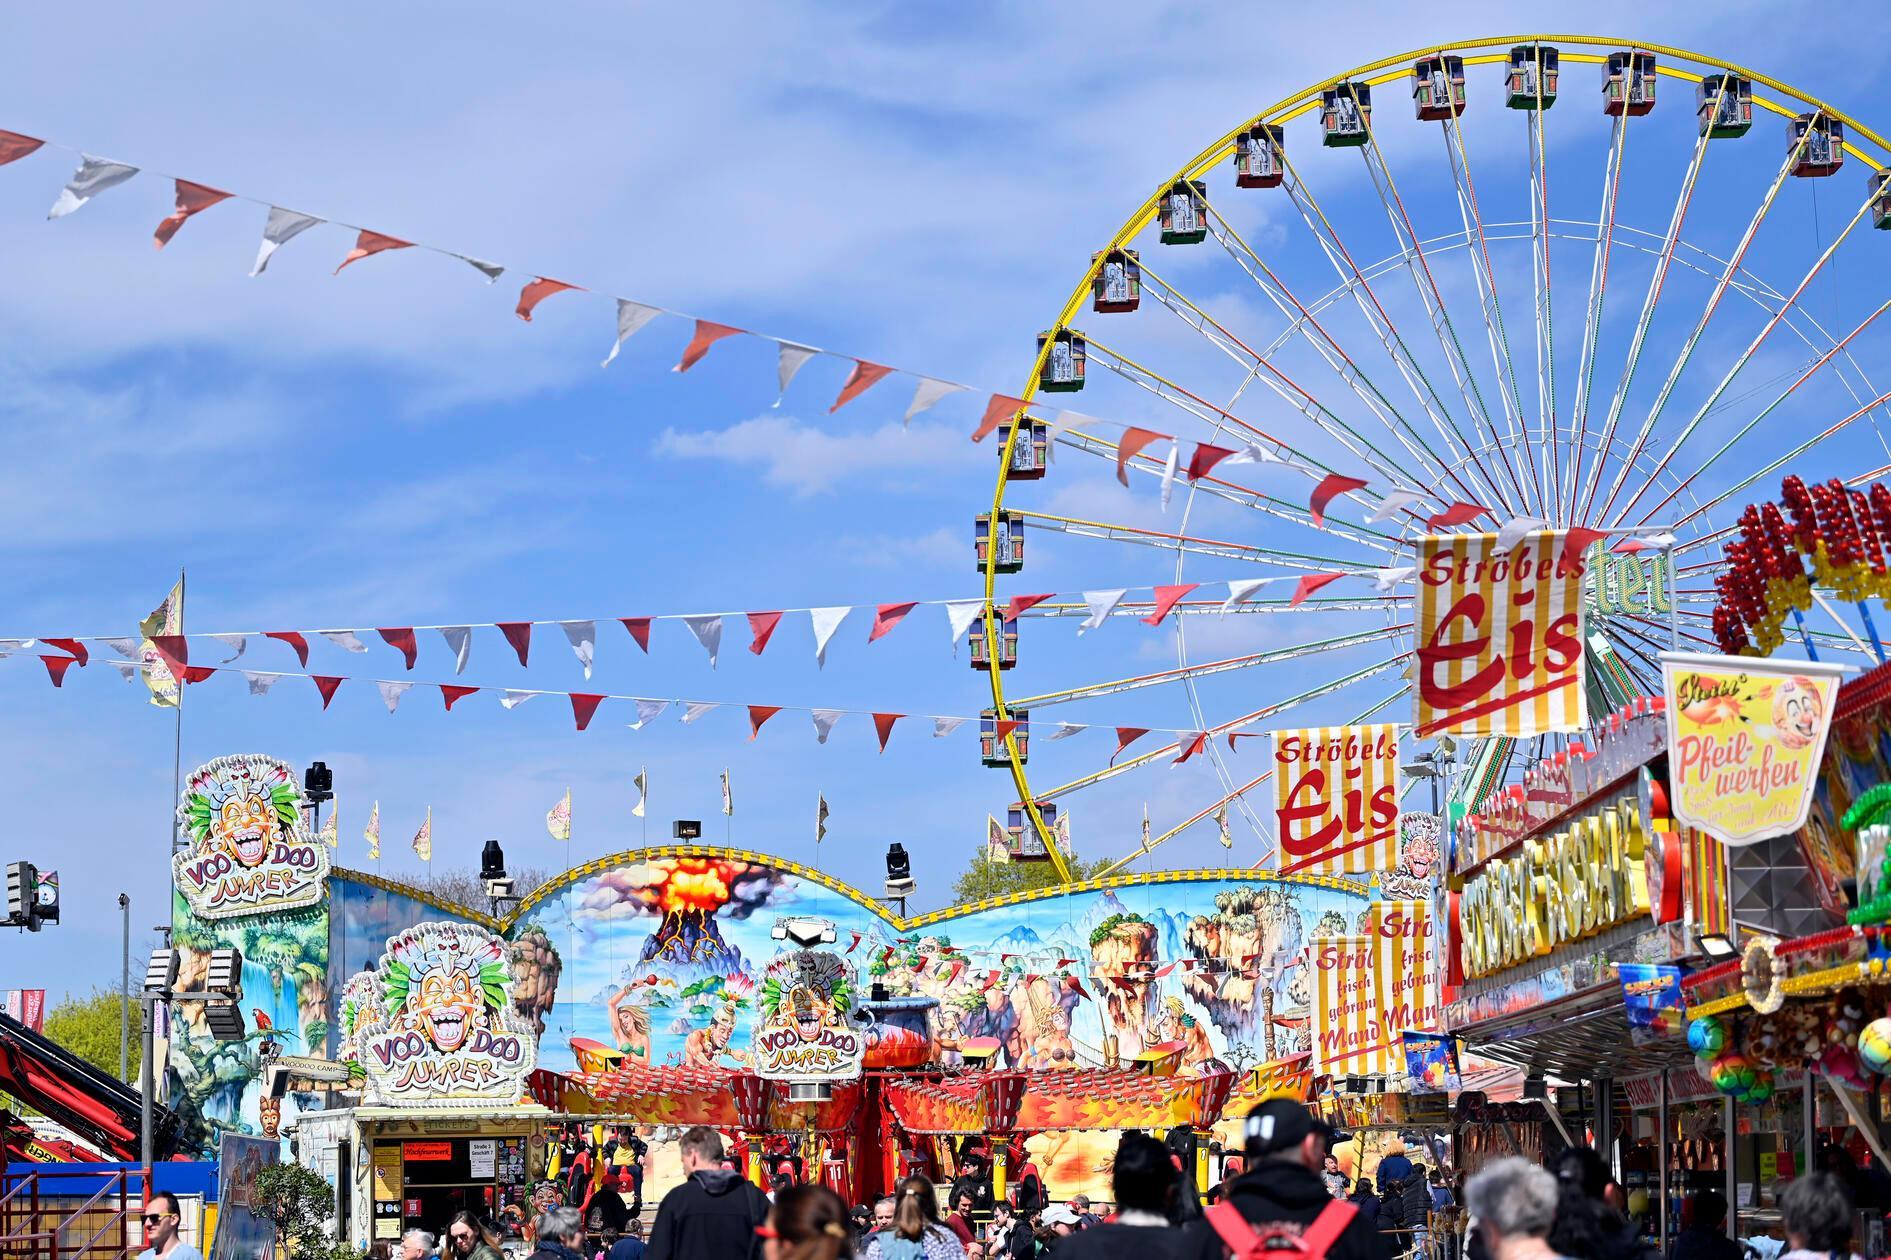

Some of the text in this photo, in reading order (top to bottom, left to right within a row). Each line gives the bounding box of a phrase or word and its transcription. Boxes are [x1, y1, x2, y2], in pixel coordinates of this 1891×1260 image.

[1420, 546, 1586, 586] Ströbels
[1417, 588, 1582, 710] Eis
[1275, 733, 1397, 763] Ströbels
[1677, 732, 1754, 785] Pfeil-
[1715, 744, 1800, 798] werfen
[1276, 766, 1398, 856] Eis
[186, 843, 315, 886] VOO DOO
[211, 868, 300, 904] JUMPER
[1378, 911, 1433, 938] Strö
[1401, 949, 1434, 970] frisc
[1337, 973, 1371, 998] frisch
[1392, 971, 1435, 997] gebra
[1383, 1002, 1436, 1032] Man
[373, 1028, 520, 1066] VOO DOO
[760, 1029, 856, 1053] VOO DOO
[1318, 1020, 1381, 1052] Mand
[285, 1060, 338, 1073] VOODOO CAMP
[396, 1058, 499, 1088] JUMPER
[770, 1048, 842, 1069] JUMPER
[429, 1120, 470, 1129] TICKETS
[829, 1166, 842, 1180] 11
[994, 1154, 1007, 1167] 12
